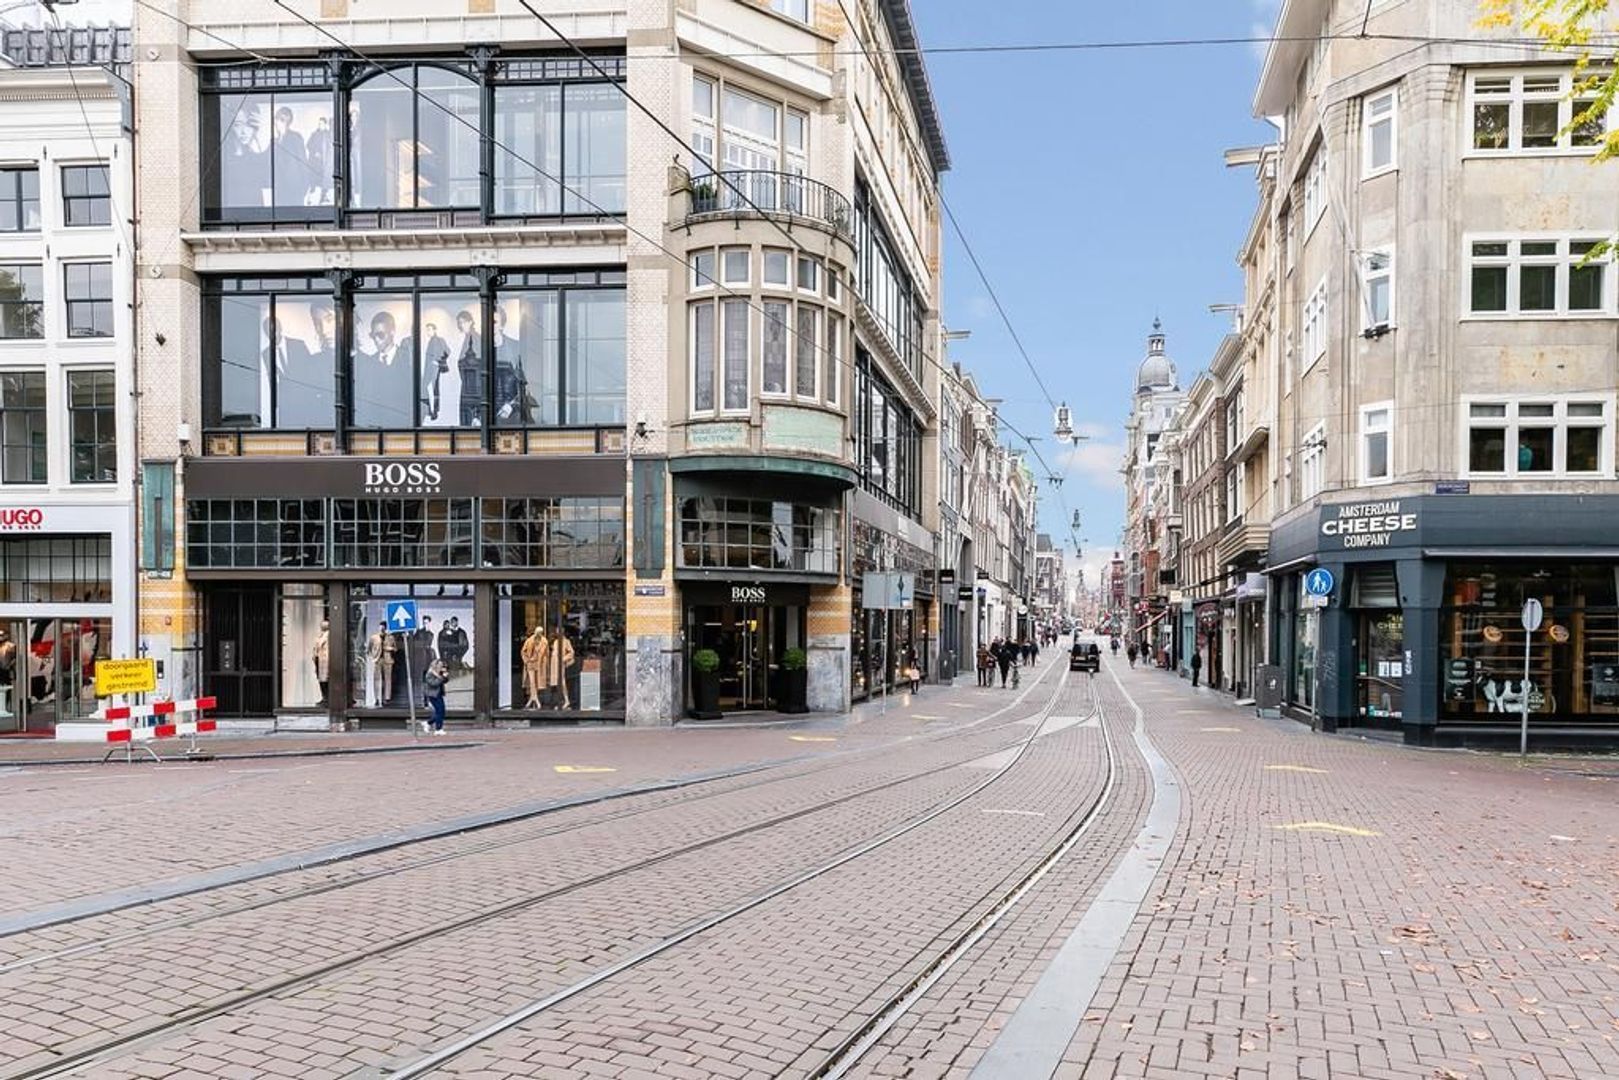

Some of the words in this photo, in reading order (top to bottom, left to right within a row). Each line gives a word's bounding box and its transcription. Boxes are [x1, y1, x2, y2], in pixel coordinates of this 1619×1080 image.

[365, 463, 441, 485] BOSS
[1339, 501, 1400, 518] AMSTERDAM
[1321, 513, 1417, 535] CHEESE
[1344, 532, 1391, 548] COMPANY
[731, 586, 766, 599] BOSS
